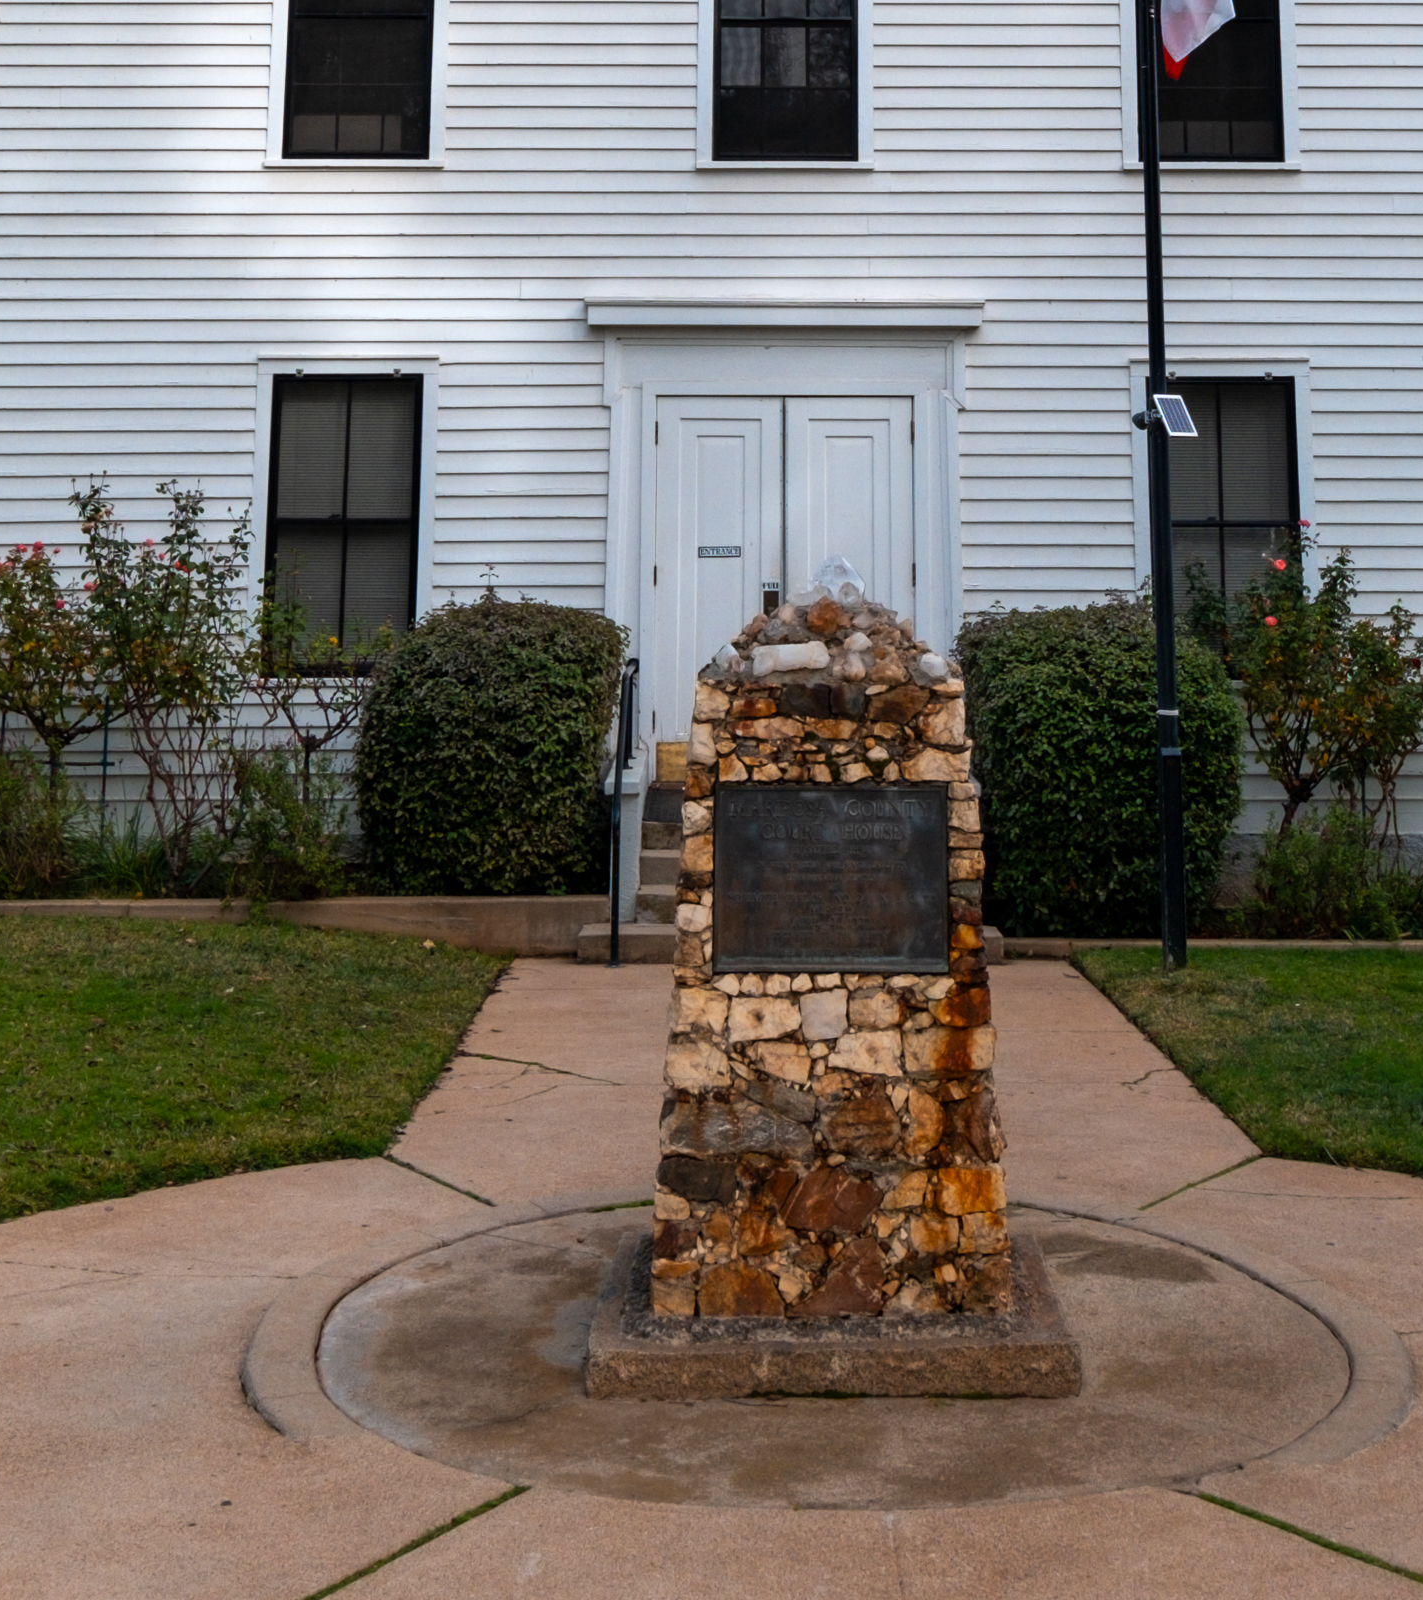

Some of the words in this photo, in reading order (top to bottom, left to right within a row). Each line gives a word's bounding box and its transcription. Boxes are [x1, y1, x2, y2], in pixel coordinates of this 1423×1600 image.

[729, 800, 828, 817] MARIPOSA
[844, 799, 931, 817] COUNTY
[761, 823, 823, 841] COURT
[841, 823, 903, 840] HOUSE
